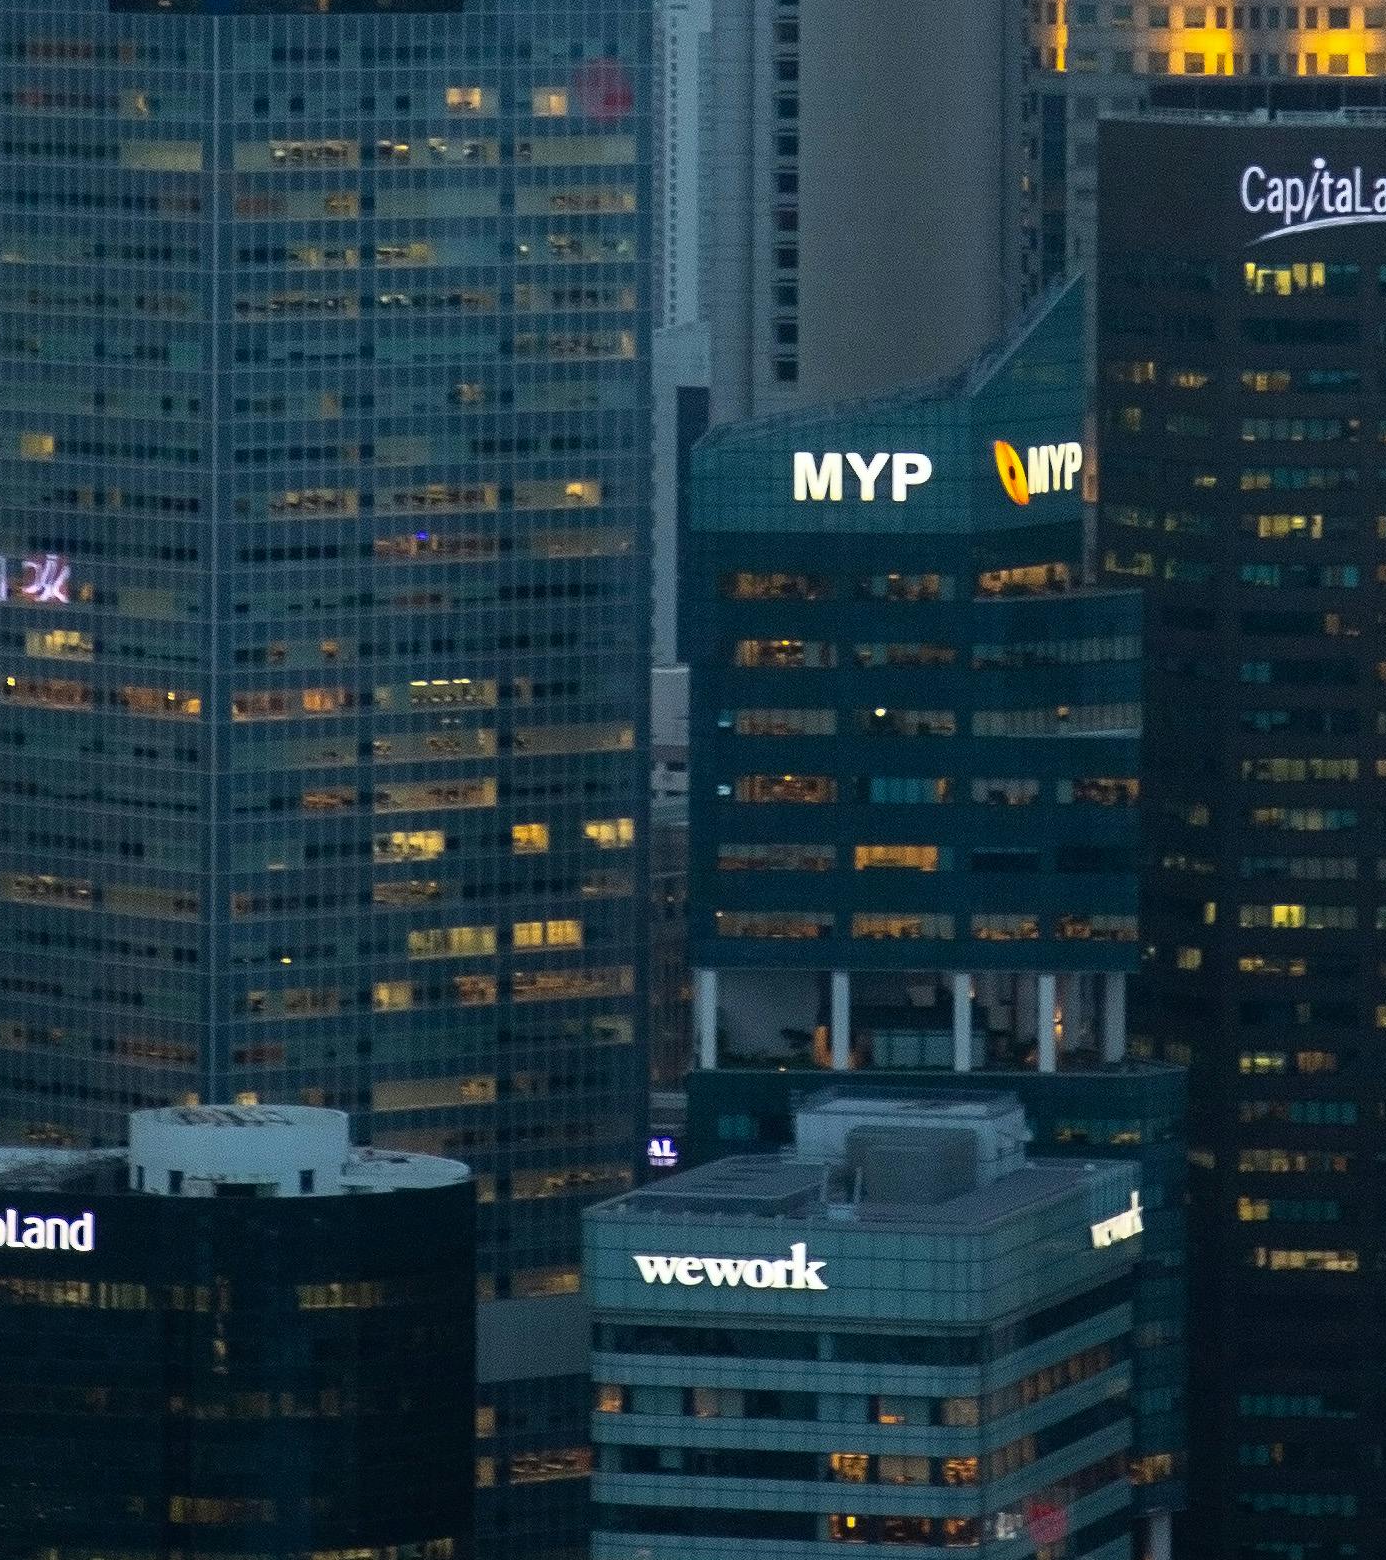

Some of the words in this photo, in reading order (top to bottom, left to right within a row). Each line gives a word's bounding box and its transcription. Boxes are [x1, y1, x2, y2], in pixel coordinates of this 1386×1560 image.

[793, 452, 933, 502] MYP
[1028, 441, 1083, 495] MYP
[633, 1242, 829, 1290] wework
